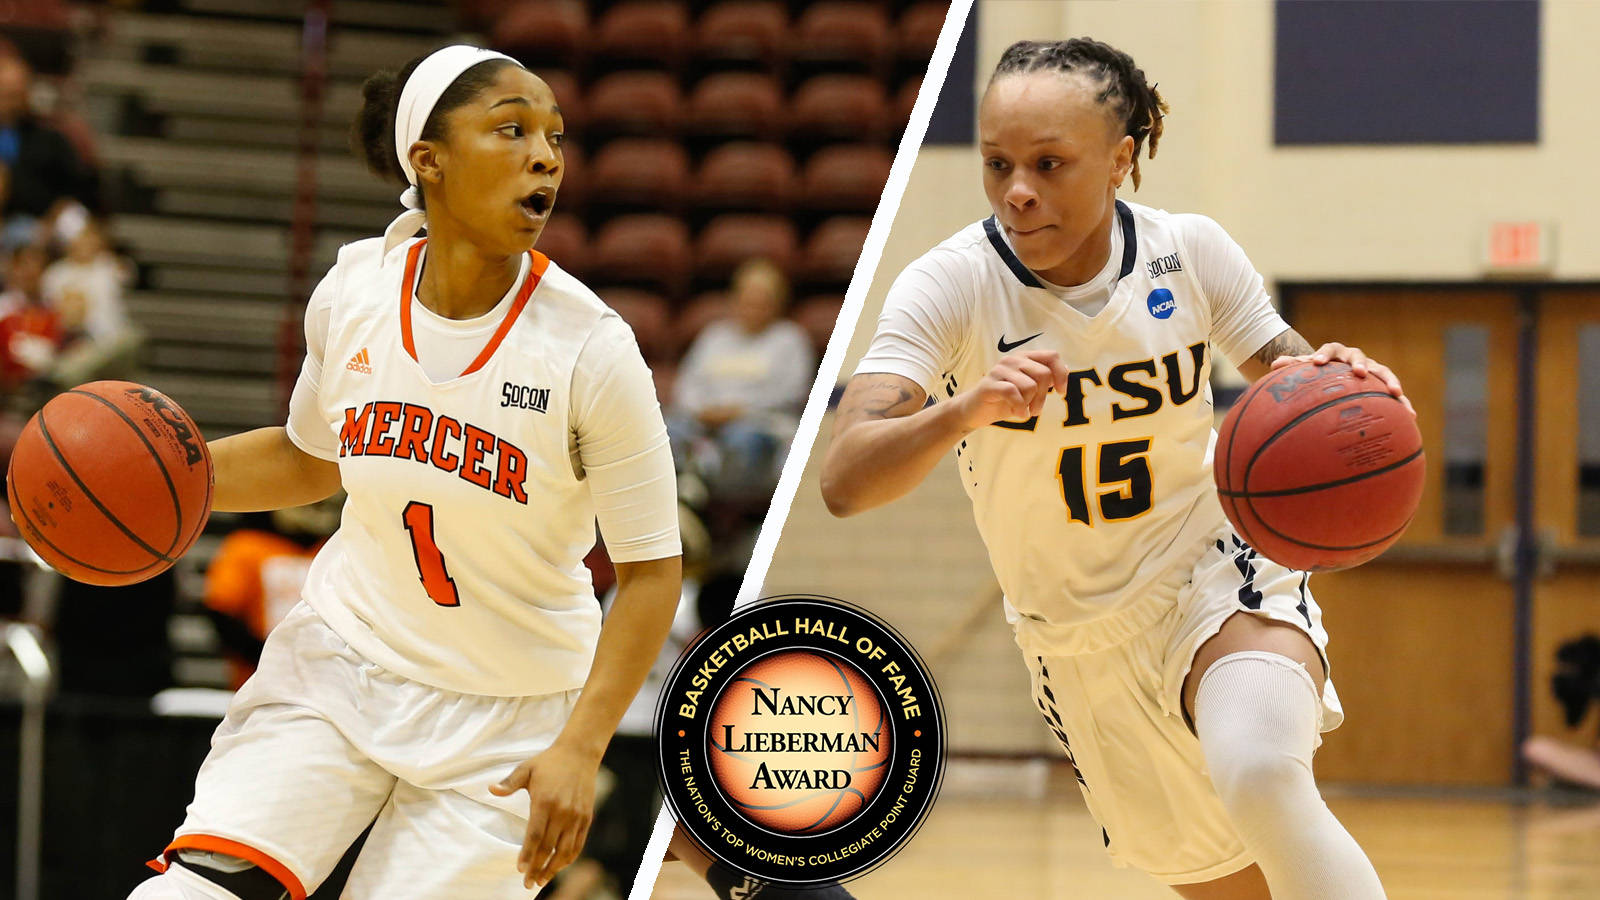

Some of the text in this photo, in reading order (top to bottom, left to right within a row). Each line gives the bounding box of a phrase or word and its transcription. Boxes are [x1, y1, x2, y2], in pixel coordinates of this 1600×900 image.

[346, 362, 372, 375] adidas
[990, 341, 1206, 432] TSU
[339, 401, 528, 505] MERCER
[1055, 436, 1154, 528] 15
[402, 500, 460, 607] 1
